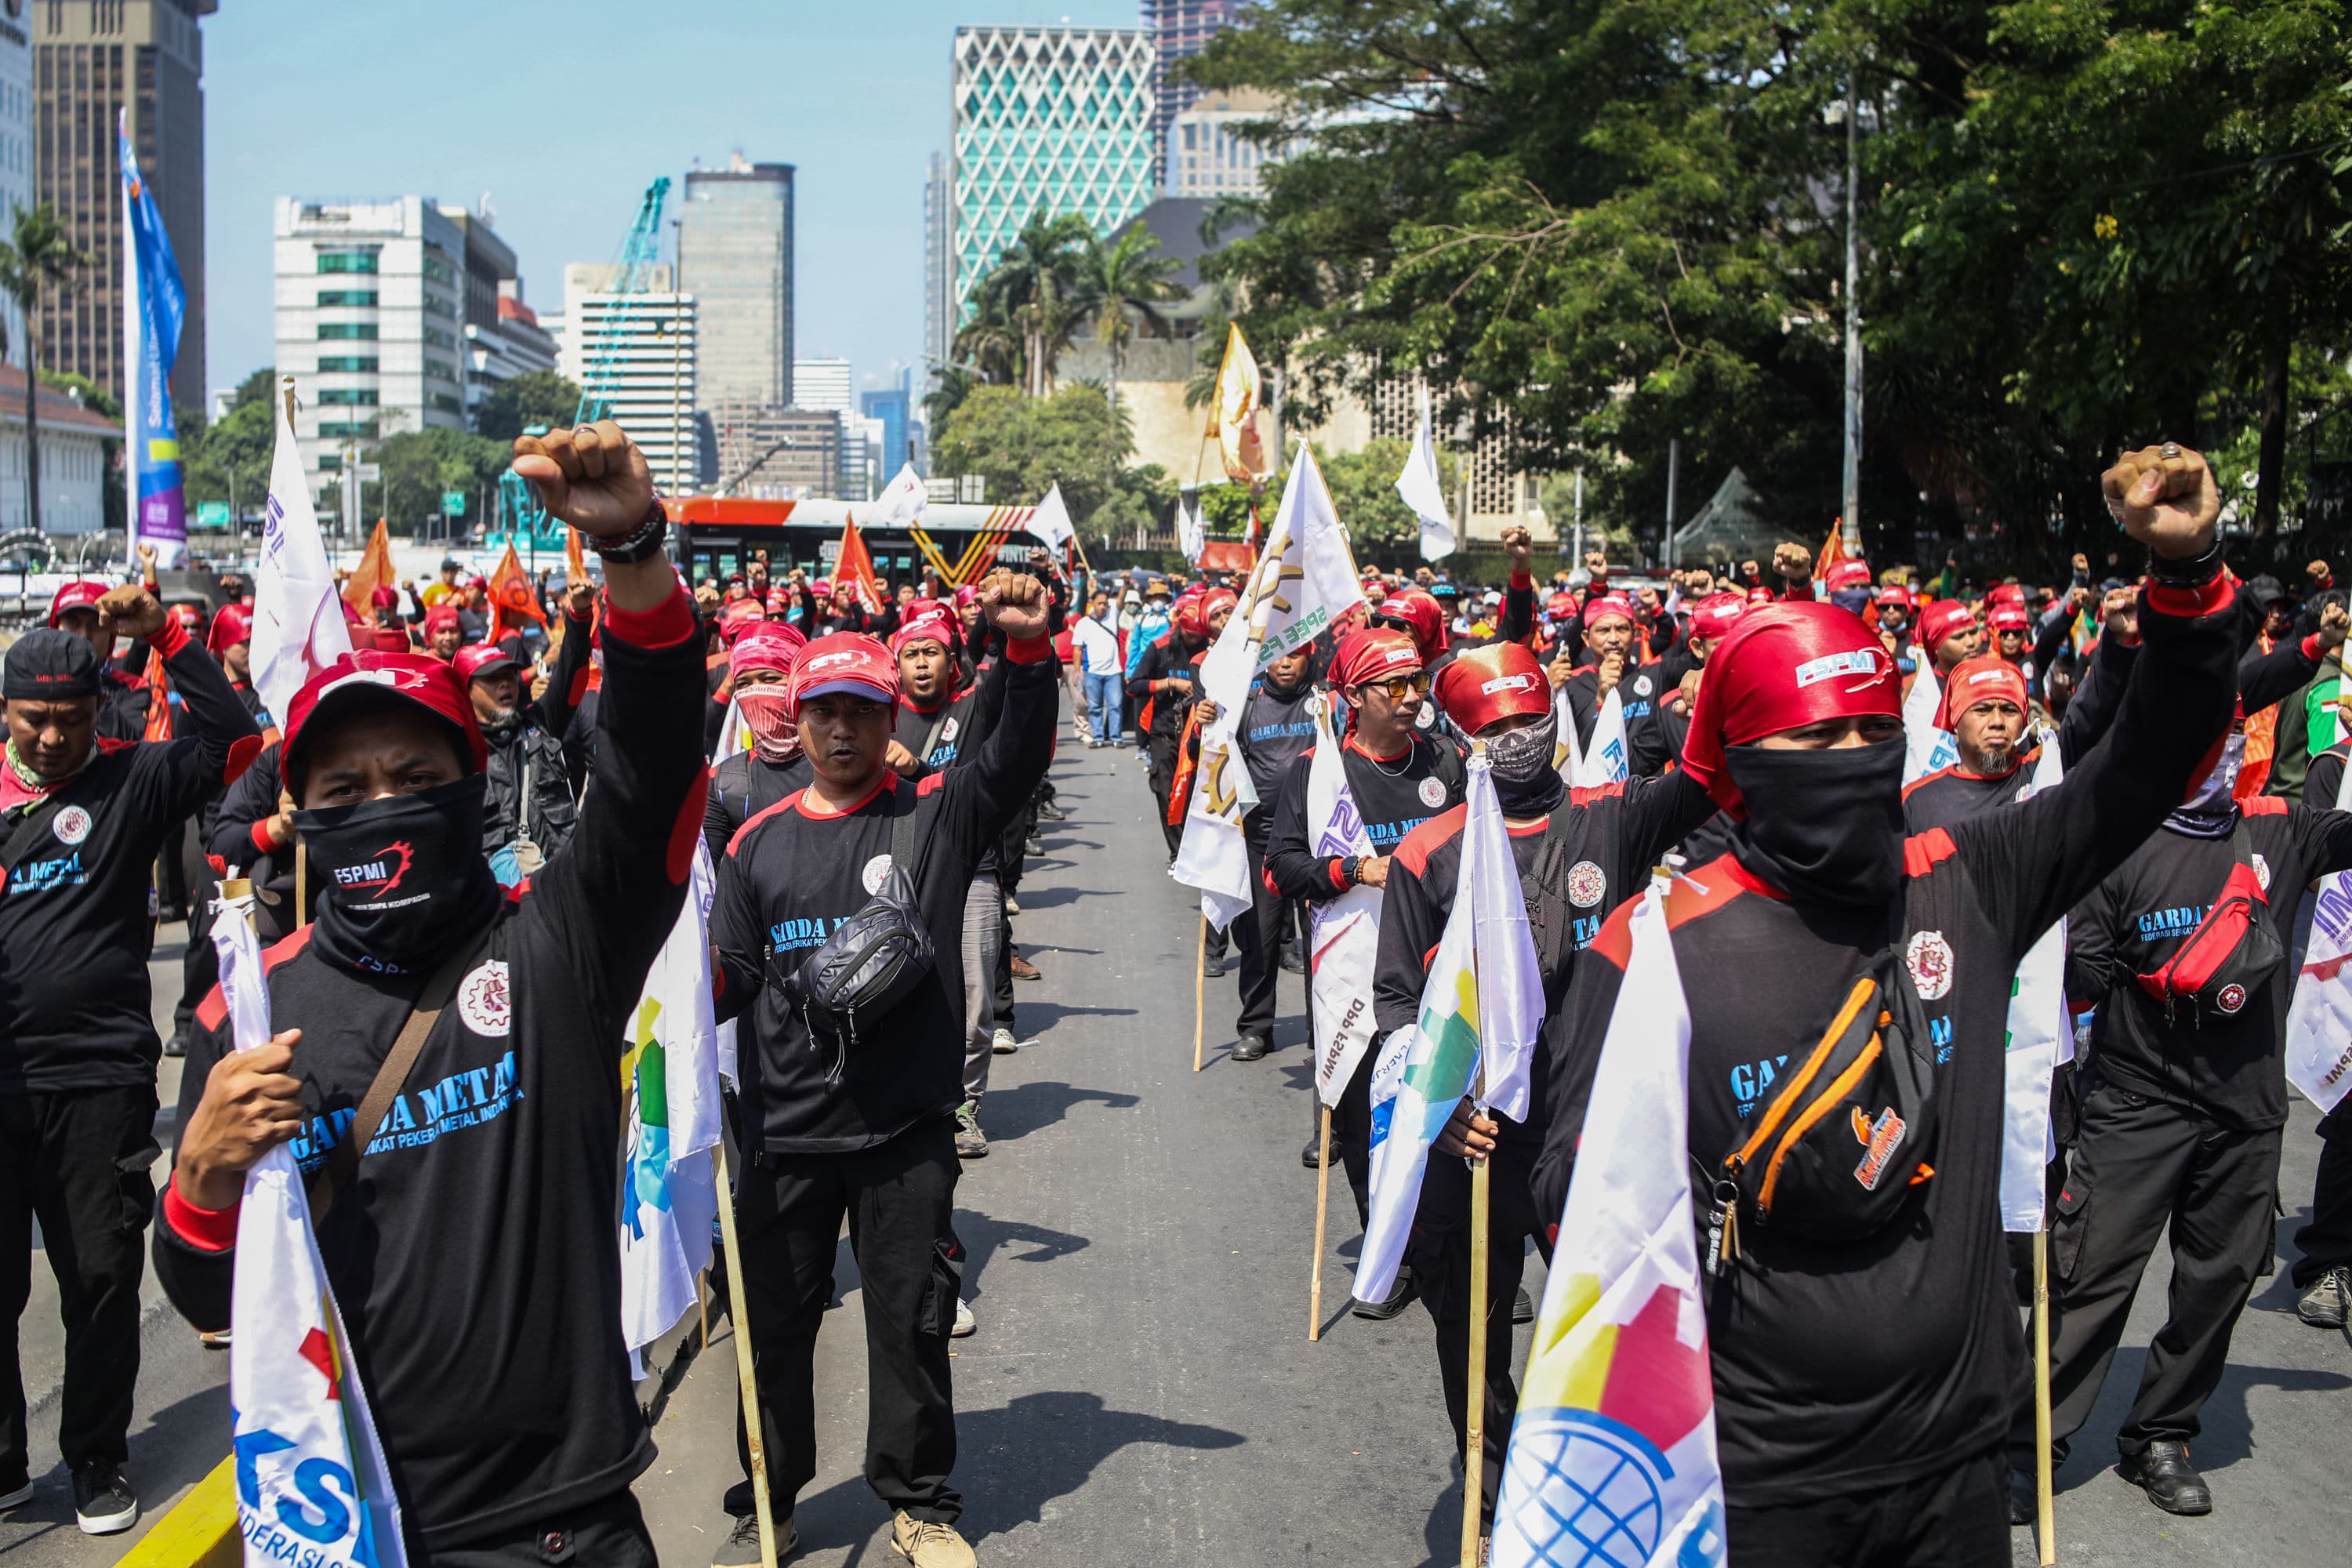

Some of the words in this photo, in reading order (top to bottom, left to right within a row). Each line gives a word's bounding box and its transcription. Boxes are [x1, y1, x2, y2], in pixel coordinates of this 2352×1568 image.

[1795, 651, 1876, 688] FSPMI
[1365, 822, 1398, 840] RDA
[30, 851, 84, 881] METAL
[334, 861, 387, 884] FSPMI
[2139, 906, 2201, 932] GARDA
[2140, 931, 2171, 942] FEDERASI
